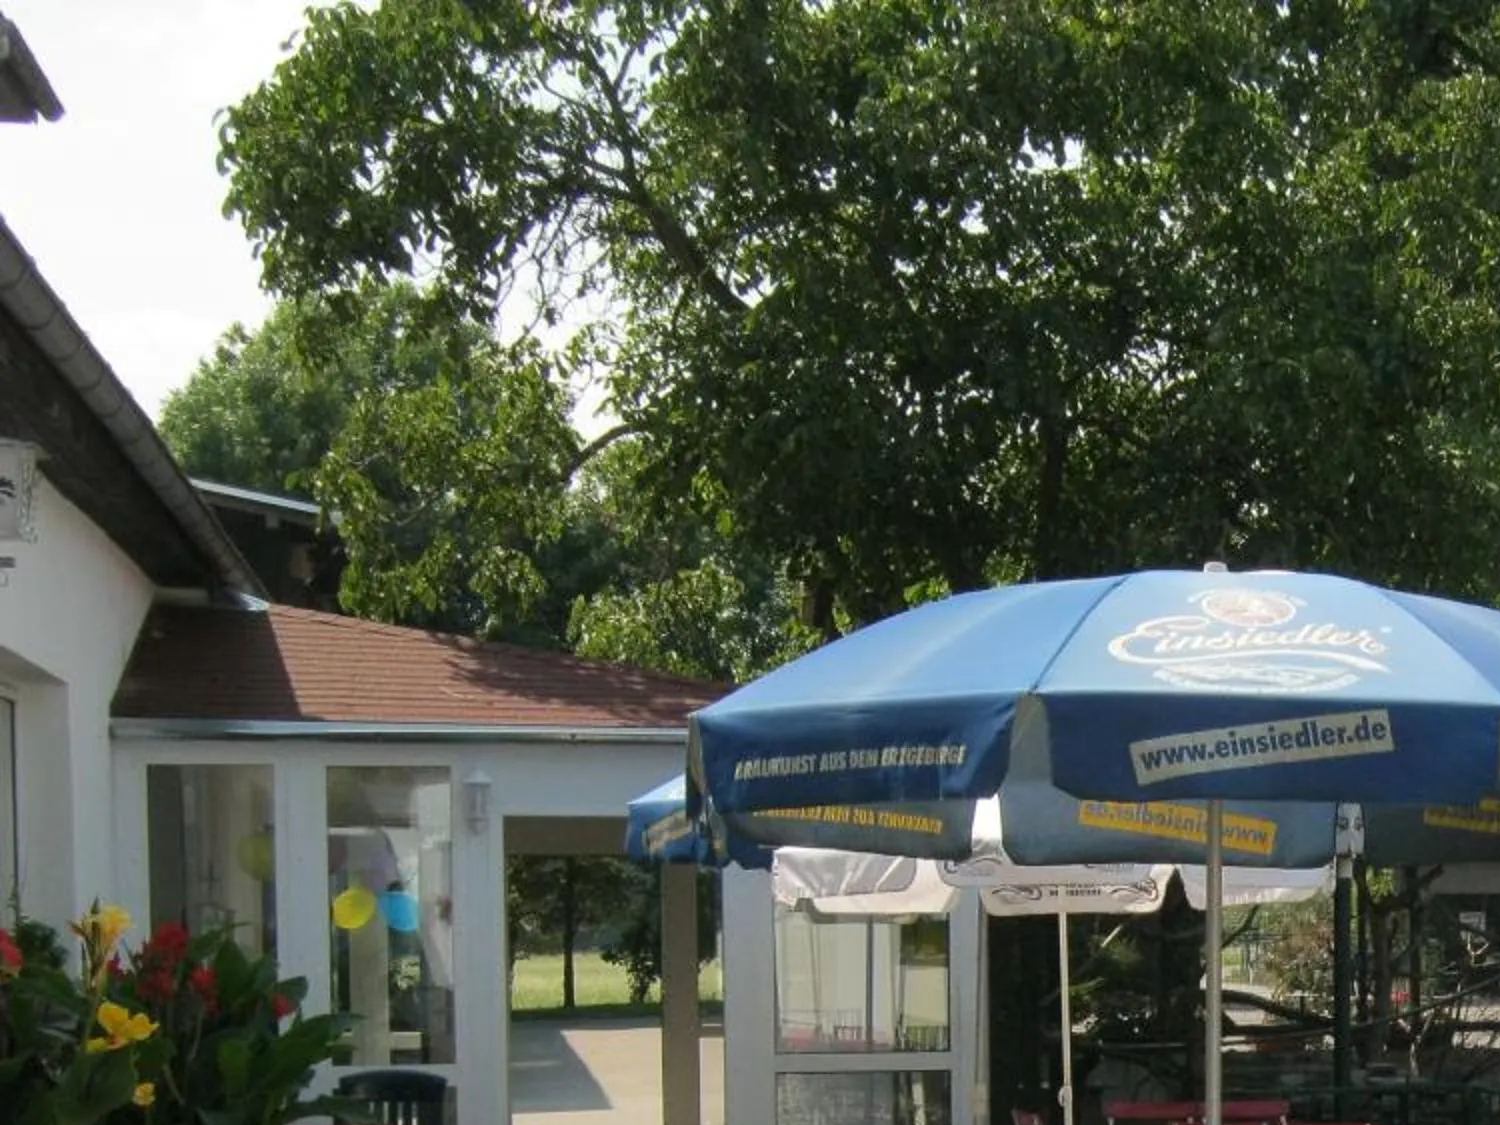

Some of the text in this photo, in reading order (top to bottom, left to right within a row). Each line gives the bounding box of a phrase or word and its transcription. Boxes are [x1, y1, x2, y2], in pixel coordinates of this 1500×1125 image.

[1107, 614, 1390, 673] Einsiedler
[819, 751, 846, 773] AUS
[1138, 715, 1388, 771] www.einsiedler.de
